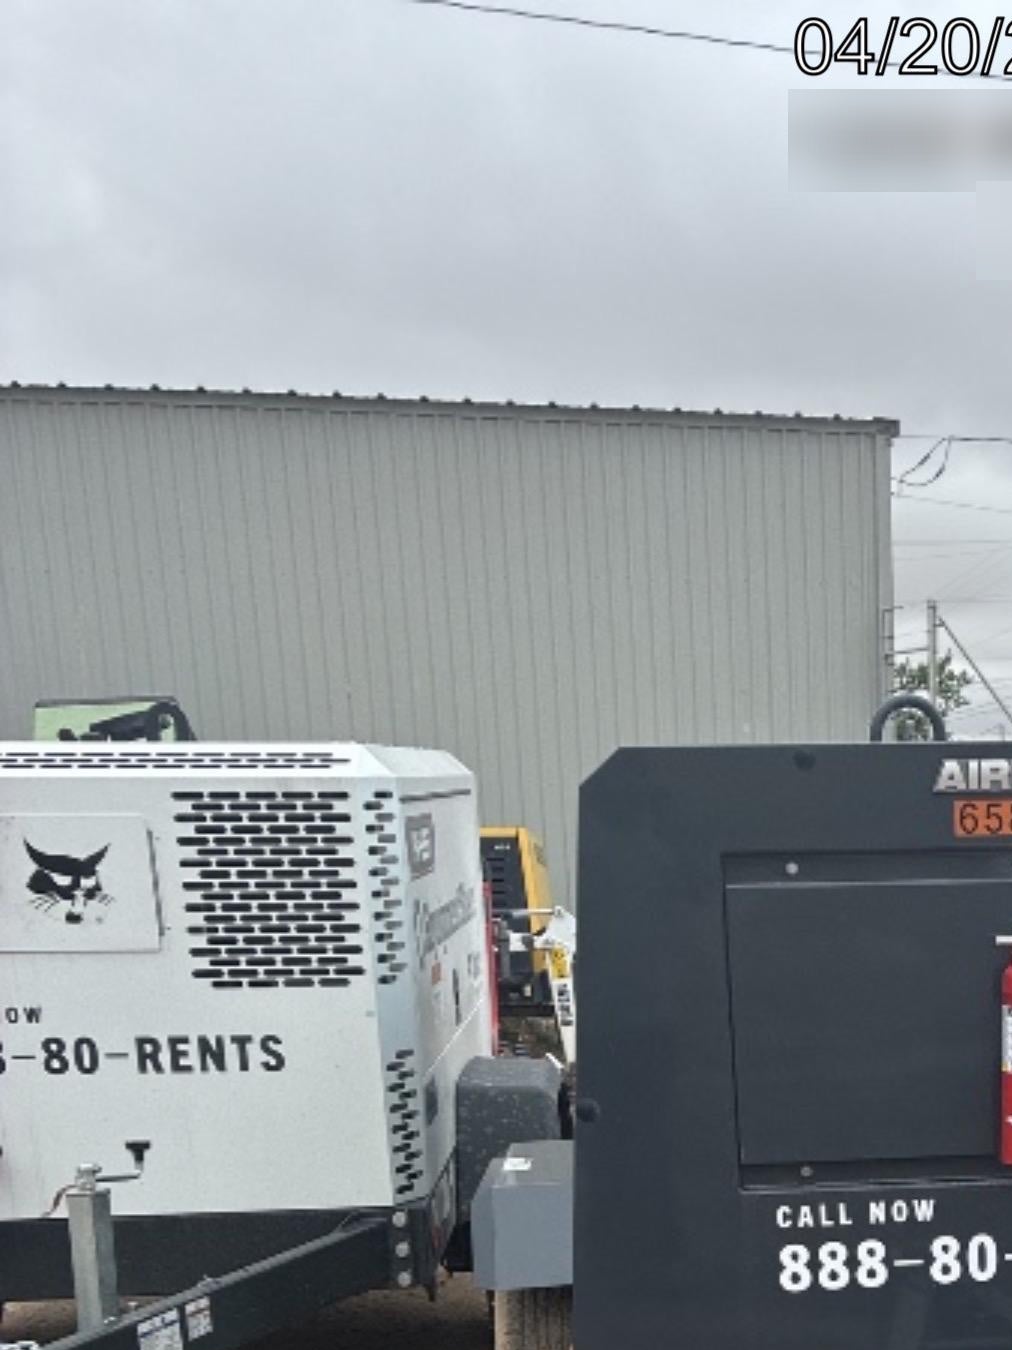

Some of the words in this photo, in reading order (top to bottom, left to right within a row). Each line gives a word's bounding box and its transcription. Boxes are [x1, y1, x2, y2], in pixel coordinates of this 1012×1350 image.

[0, 1034, 286, 1075] -80-RENTS
[776, 1203, 853, 1229] CALL
[869, 1199, 936, 1225] NOW
